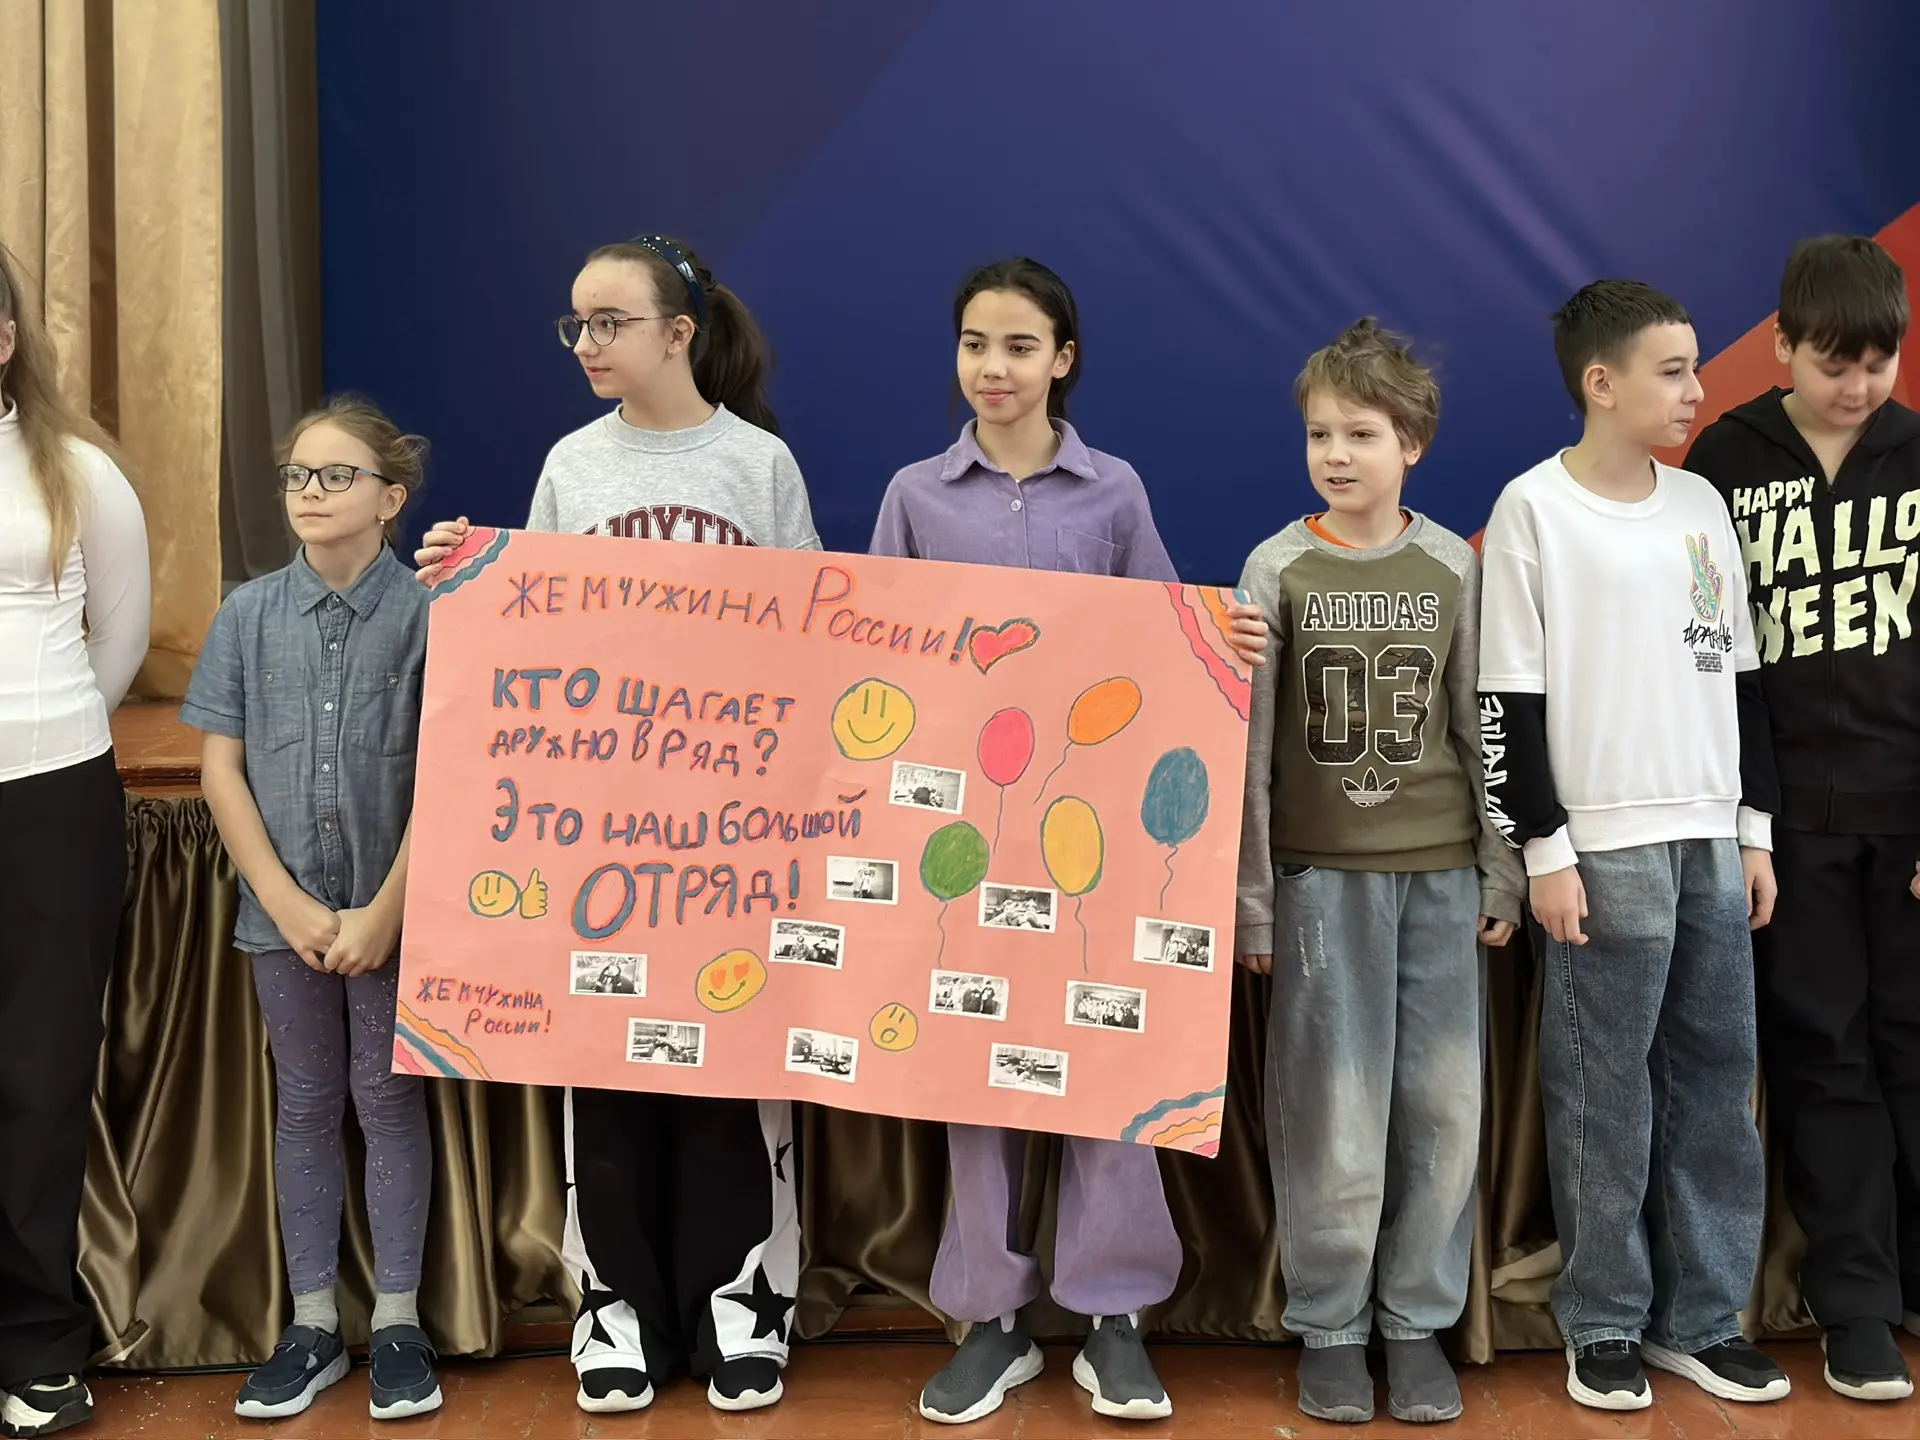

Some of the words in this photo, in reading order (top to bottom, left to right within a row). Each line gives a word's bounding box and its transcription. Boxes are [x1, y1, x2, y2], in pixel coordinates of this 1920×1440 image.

[1733, 476, 1815, 518] HAPPY
[502, 572, 783, 631] ЖЕМЧУЖИНА
[1302, 592, 1439, 631] ADIDAS
[492, 667, 601, 711] КТО
[617, 676, 796, 726] ШАГАЕТ
[1302, 645, 1437, 765] 03
[602, 811, 709, 851] НАШ
[570, 858, 800, 940] ОТРЯД!
[416, 976, 544, 1011] ЖЕМЧУЖИНА
